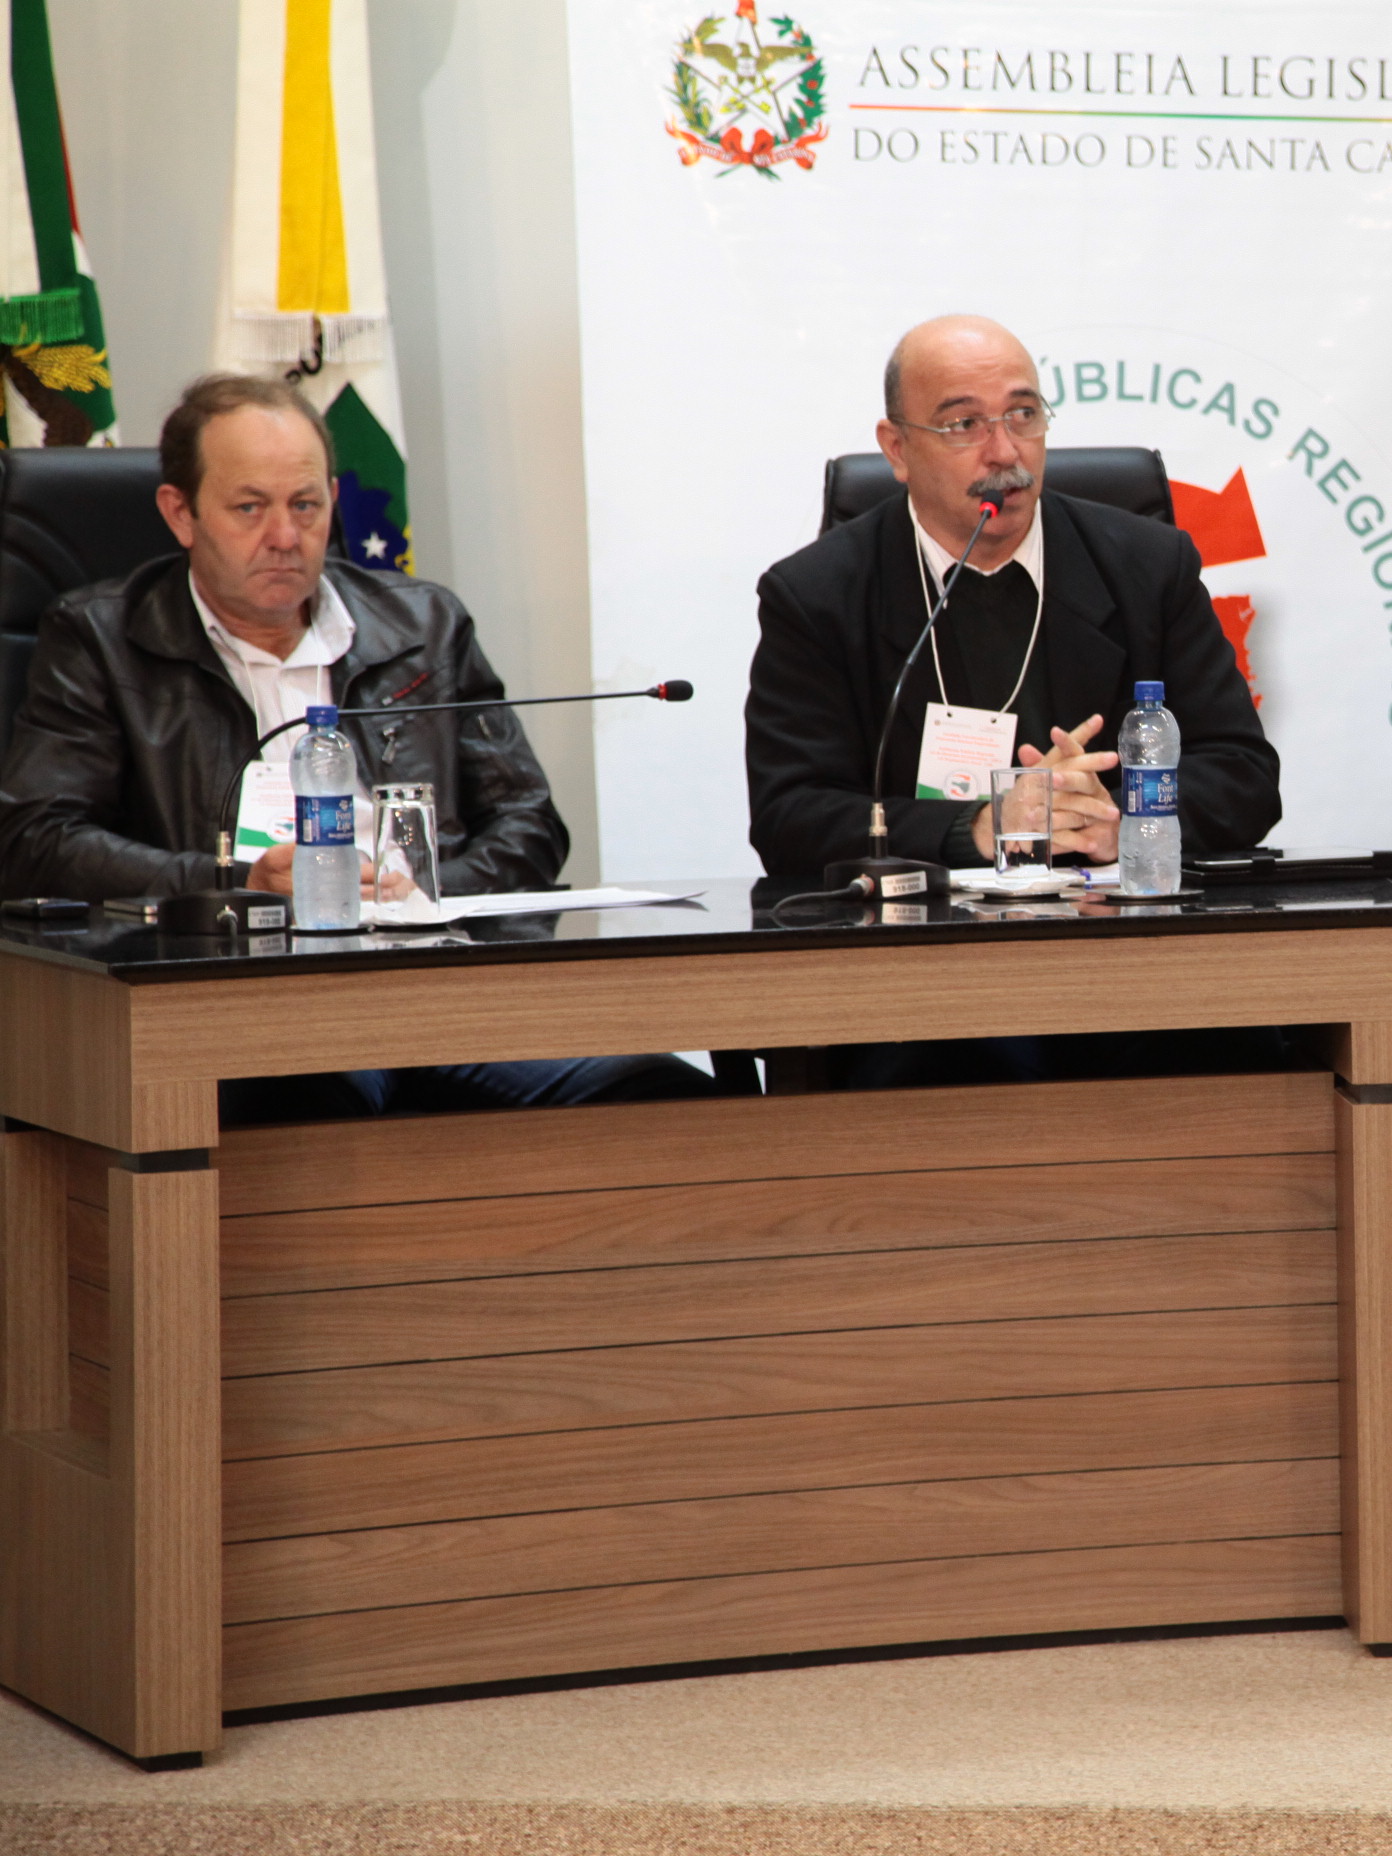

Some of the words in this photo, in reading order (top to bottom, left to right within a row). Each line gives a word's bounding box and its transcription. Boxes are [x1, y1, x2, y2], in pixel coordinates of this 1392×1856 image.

[857, 45, 1198, 97] ASSEMBLEIA
[853, 127, 919, 164] DO
[939, 129, 1106, 168] ESTADO
[1125, 134, 1178, 170] DE
[1195, 134, 1331, 172] SANTA
[1040, 355, 1281, 441] ÚBLICAS
